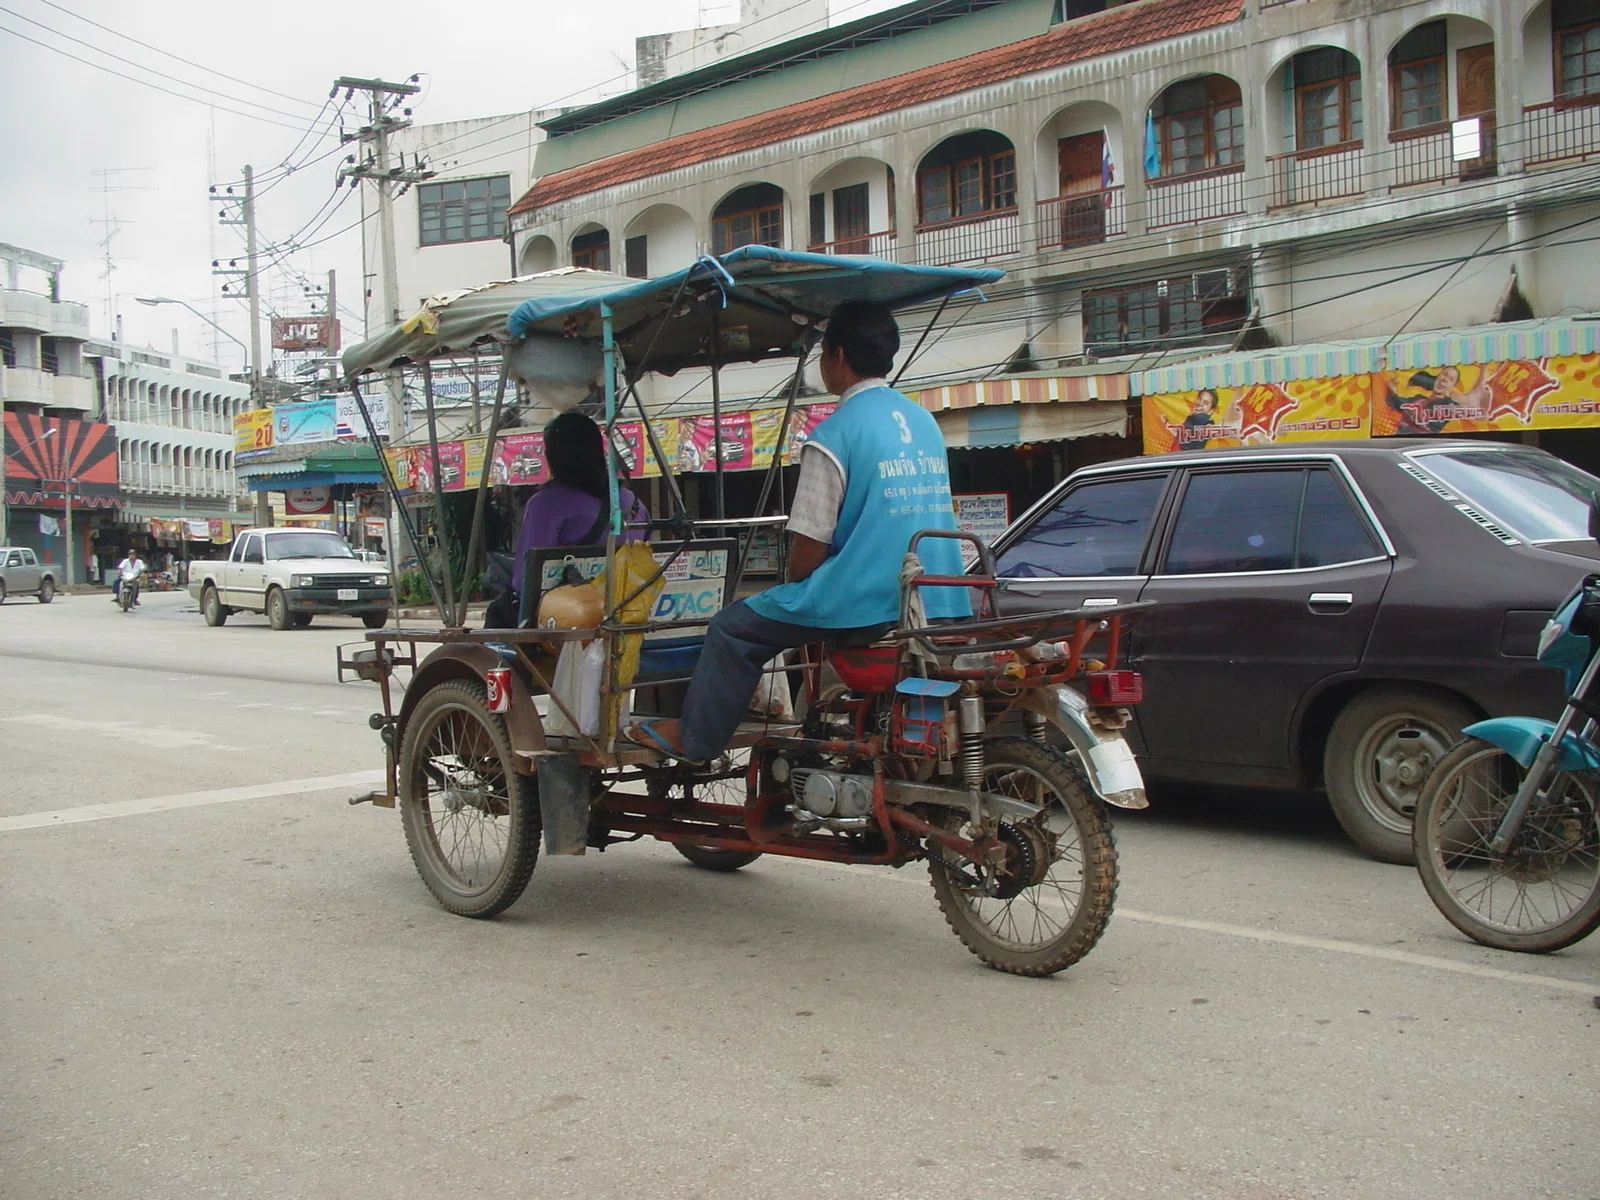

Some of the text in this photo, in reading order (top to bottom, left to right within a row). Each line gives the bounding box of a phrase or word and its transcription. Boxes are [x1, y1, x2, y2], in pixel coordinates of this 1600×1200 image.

[283, 325, 318, 341] JVC
[892, 410, 912, 444] 3
[654, 591, 714, 617] DTAC
